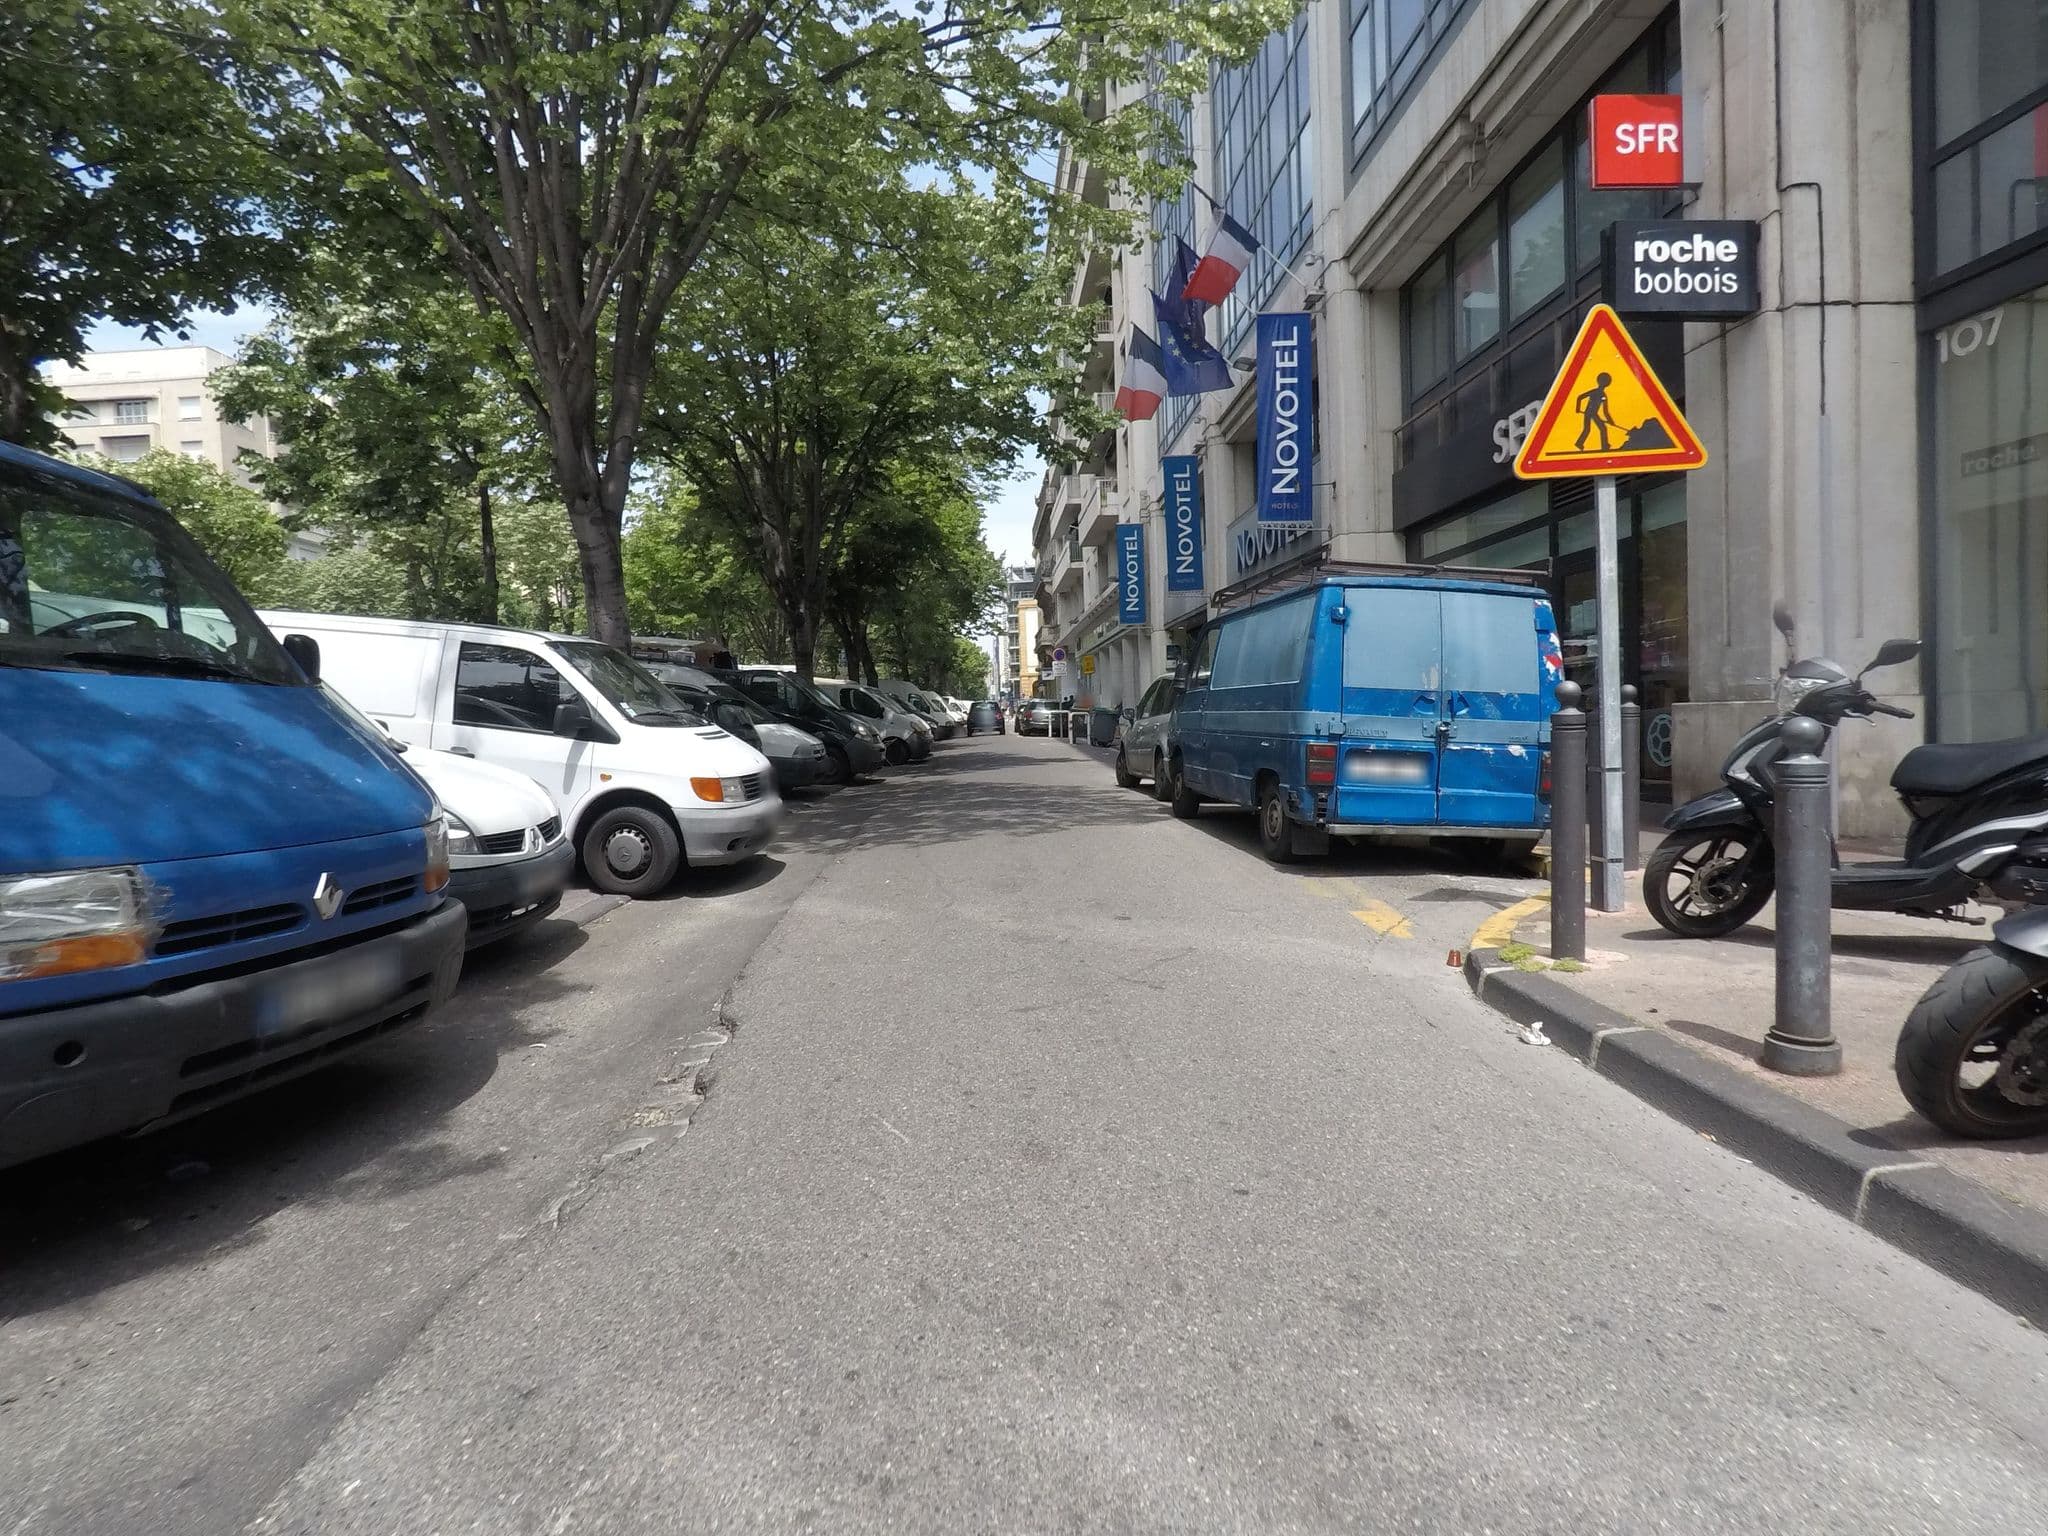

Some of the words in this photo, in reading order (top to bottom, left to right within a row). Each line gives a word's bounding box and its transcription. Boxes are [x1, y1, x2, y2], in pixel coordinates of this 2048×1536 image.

[1615, 123, 1679, 154] SFR
[1634, 234, 1738, 262] roche
[1634, 267, 1738, 293] bobois
[1936, 307, 2005, 363] 107
[1271, 326, 1299, 494] NOVOTEL
[1173, 464, 1195, 574] NOVOTEL
[1124, 530, 1139, 611] NOVOTEL
